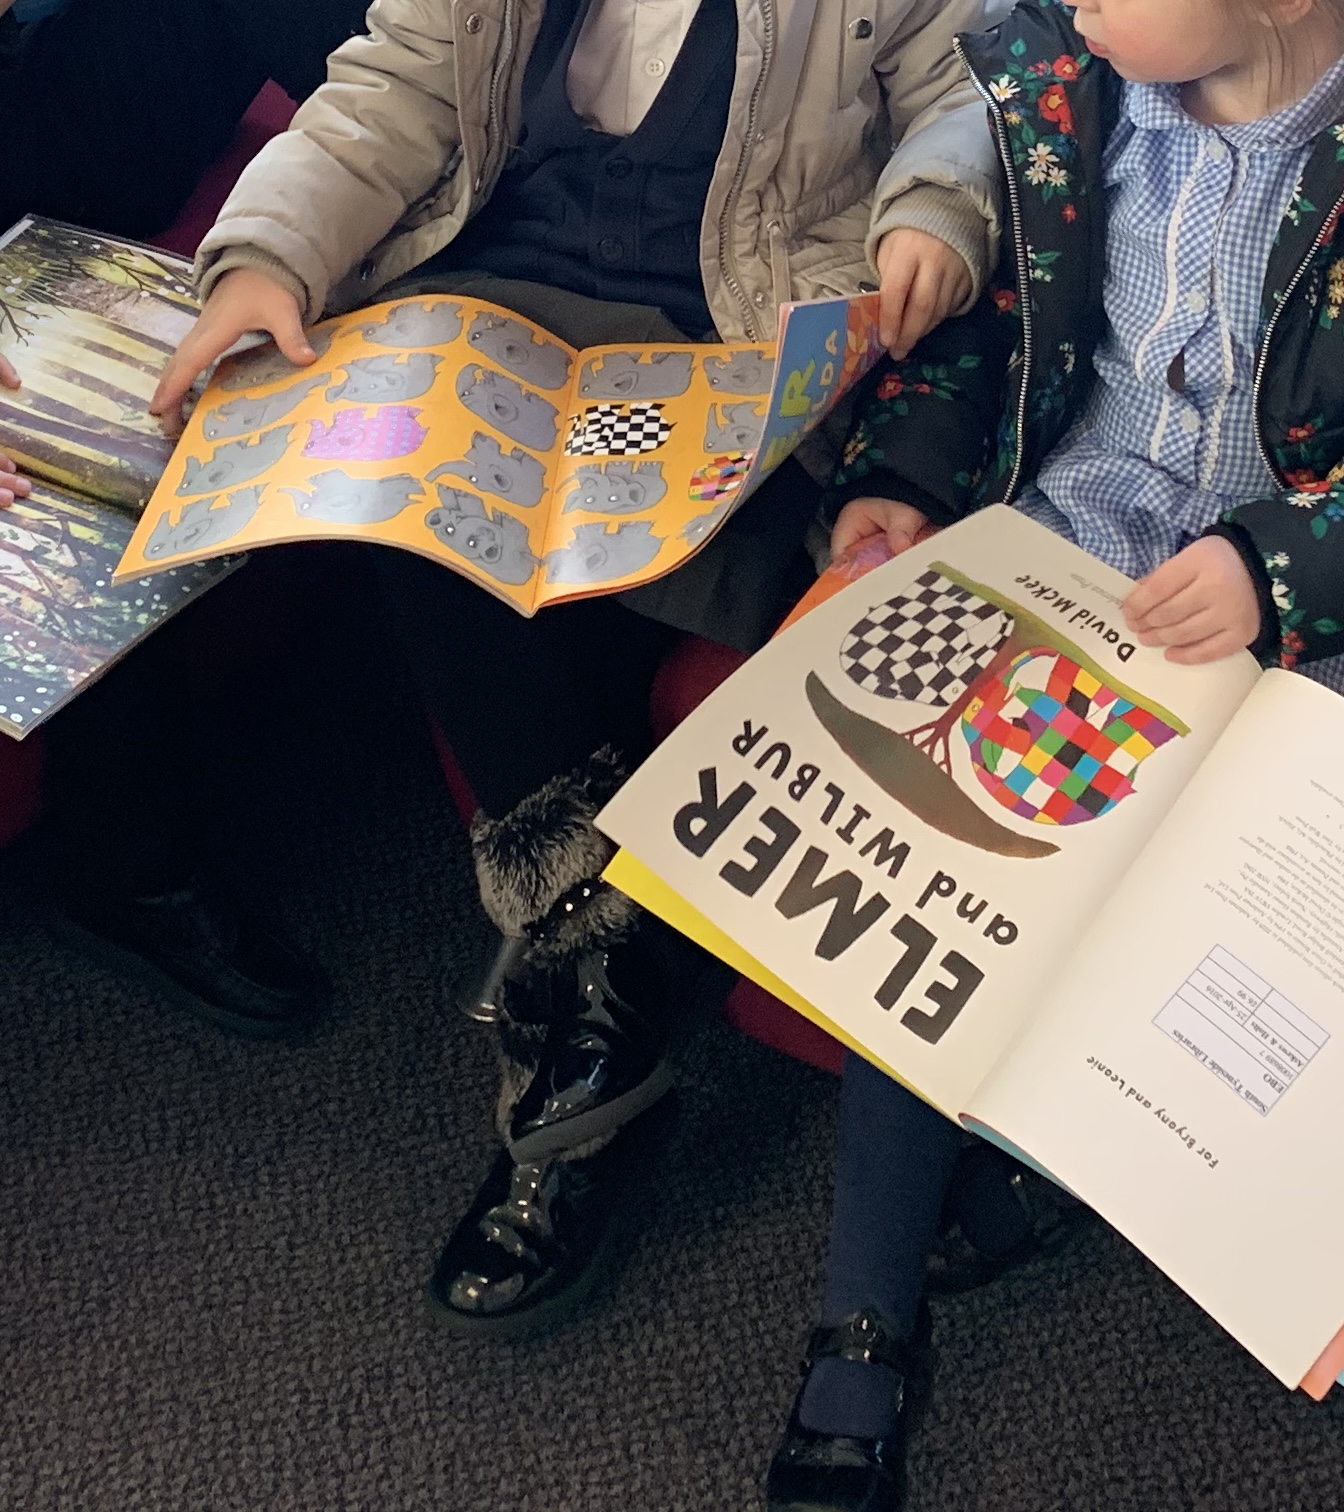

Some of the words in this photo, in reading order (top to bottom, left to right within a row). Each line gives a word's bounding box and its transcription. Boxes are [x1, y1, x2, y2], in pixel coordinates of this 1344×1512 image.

[1015, 575, 1076, 613] McKee
[1068, 609, 1136, 662] David
[732, 720, 911, 878] WILBUR
[671, 766, 986, 1046] ELMER
[915, 870, 1018, 945] and
[1170, 1027, 1209, 1063] Libraries
[1248, 1020, 1270, 1040] Holts
[1268, 1036, 1278, 1047] &
[1087, 1057, 1125, 1090] Leonie
[1206, 1057, 1245, 1092] Tyneside
[1261, 1072, 1285, 1093] EBO
[1125, 1087, 1151, 1108] and
[1242, 1088, 1269, 1113] South
[1154, 1108, 1196, 1149] Bryony
[1197, 1148, 1218, 1168] For
